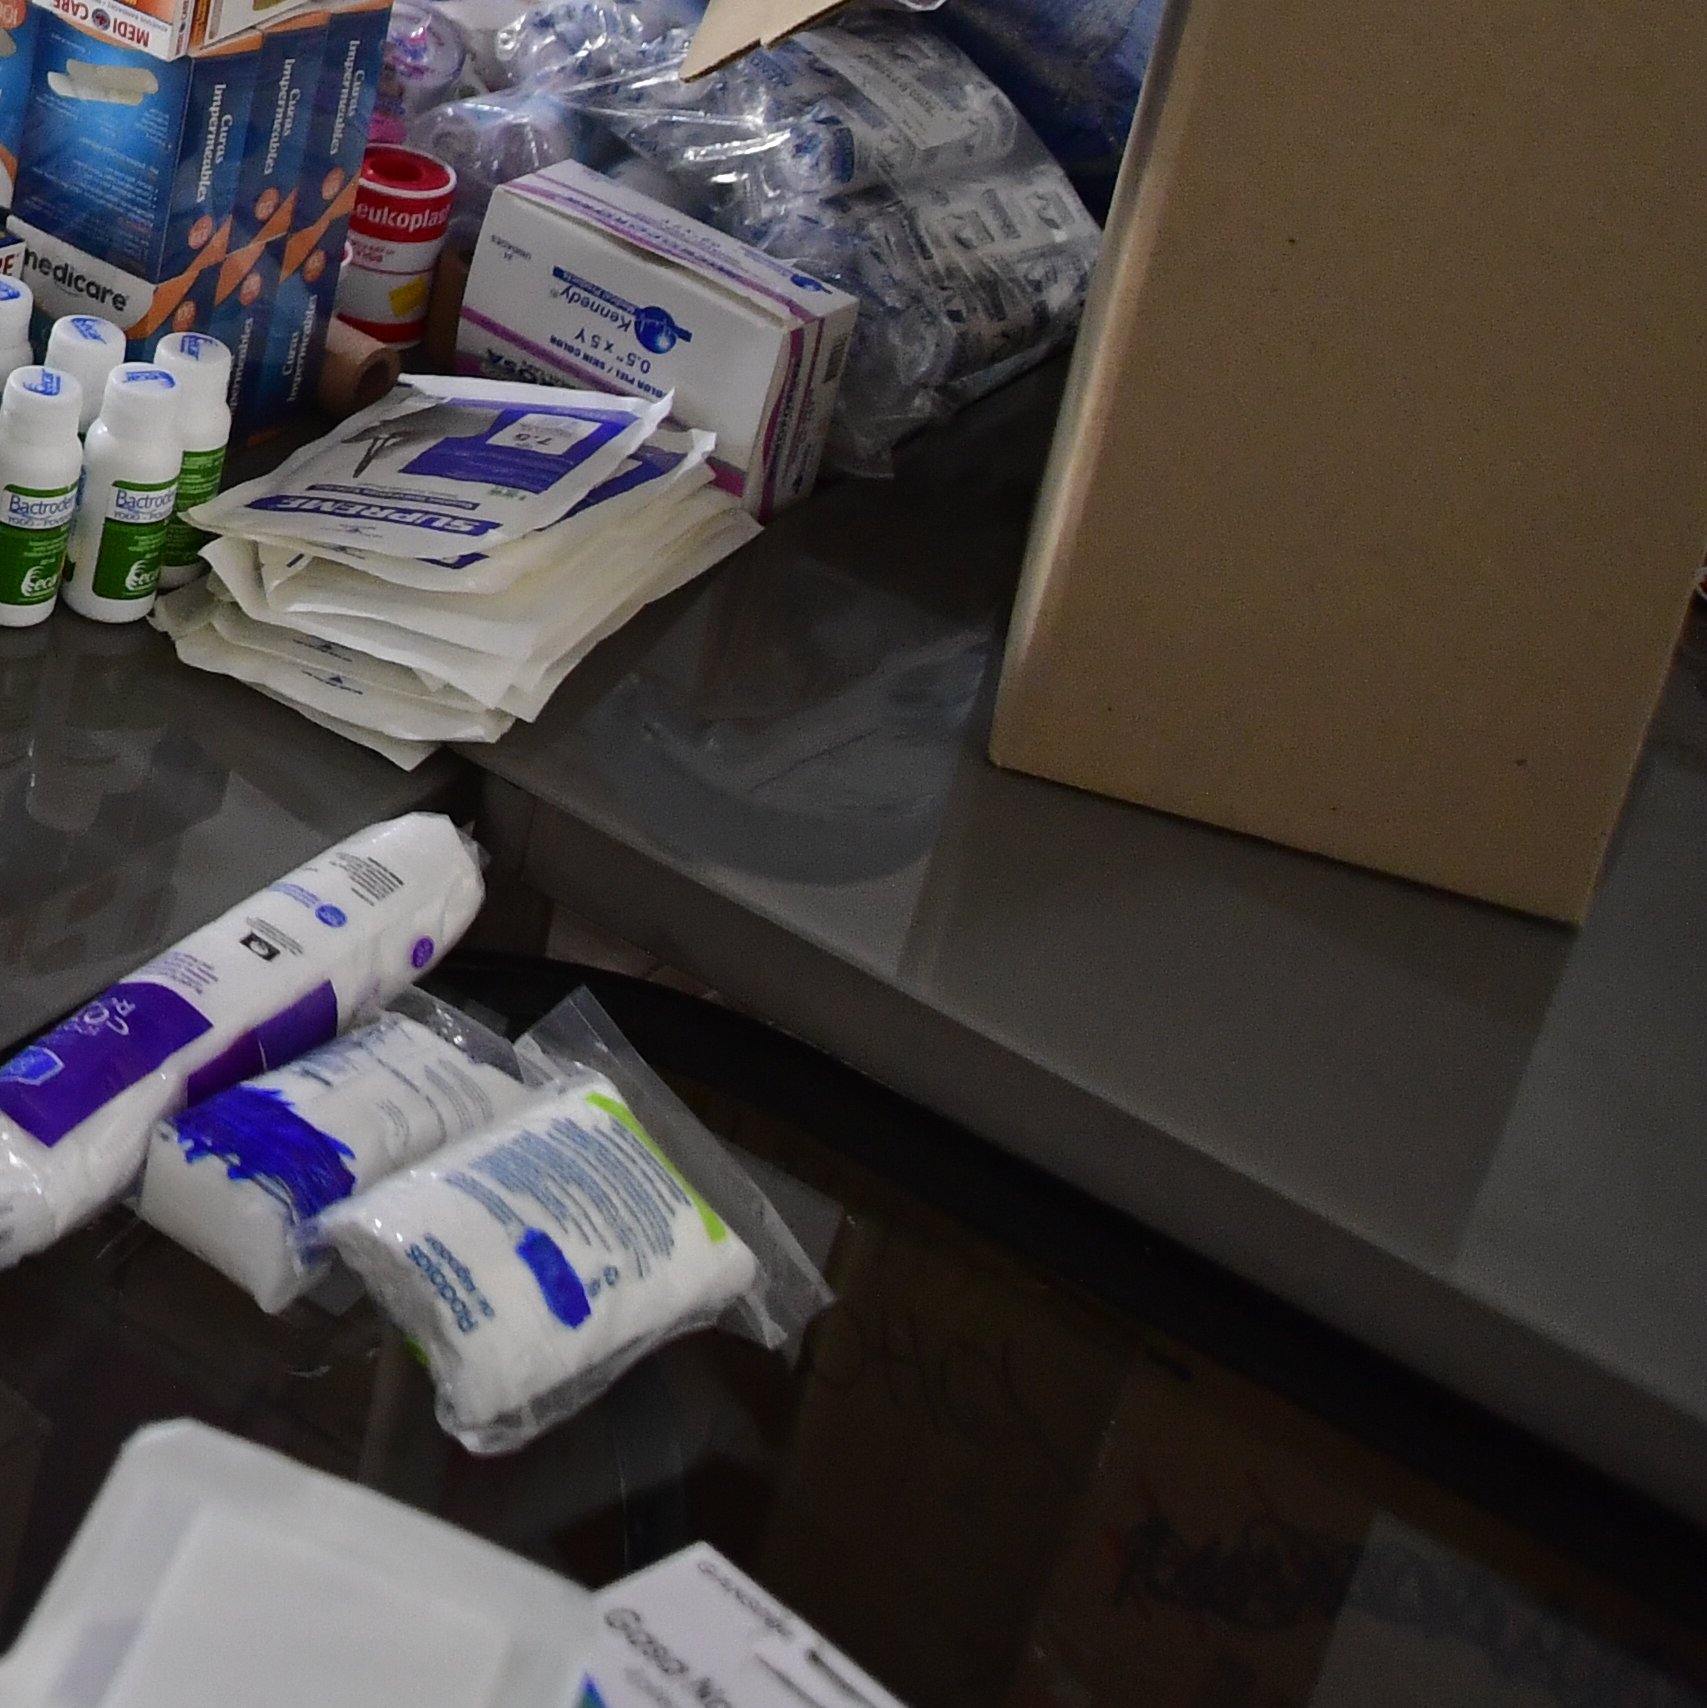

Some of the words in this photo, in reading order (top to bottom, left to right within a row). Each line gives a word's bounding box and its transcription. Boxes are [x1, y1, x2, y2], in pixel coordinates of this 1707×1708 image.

[112, 17, 150, 48] MEDI
[264, 56, 296, 177] Impermeables
[282, 86, 302, 138] Curas
[329, 38, 361, 157] Impermeables
[349, 67, 366, 118] Curas
[194, 83, 228, 204] Impermeables
[213, 113, 234, 165] Curas
[556, 285, 632, 336] Kennedy
[573, 327, 587, 344] Y
